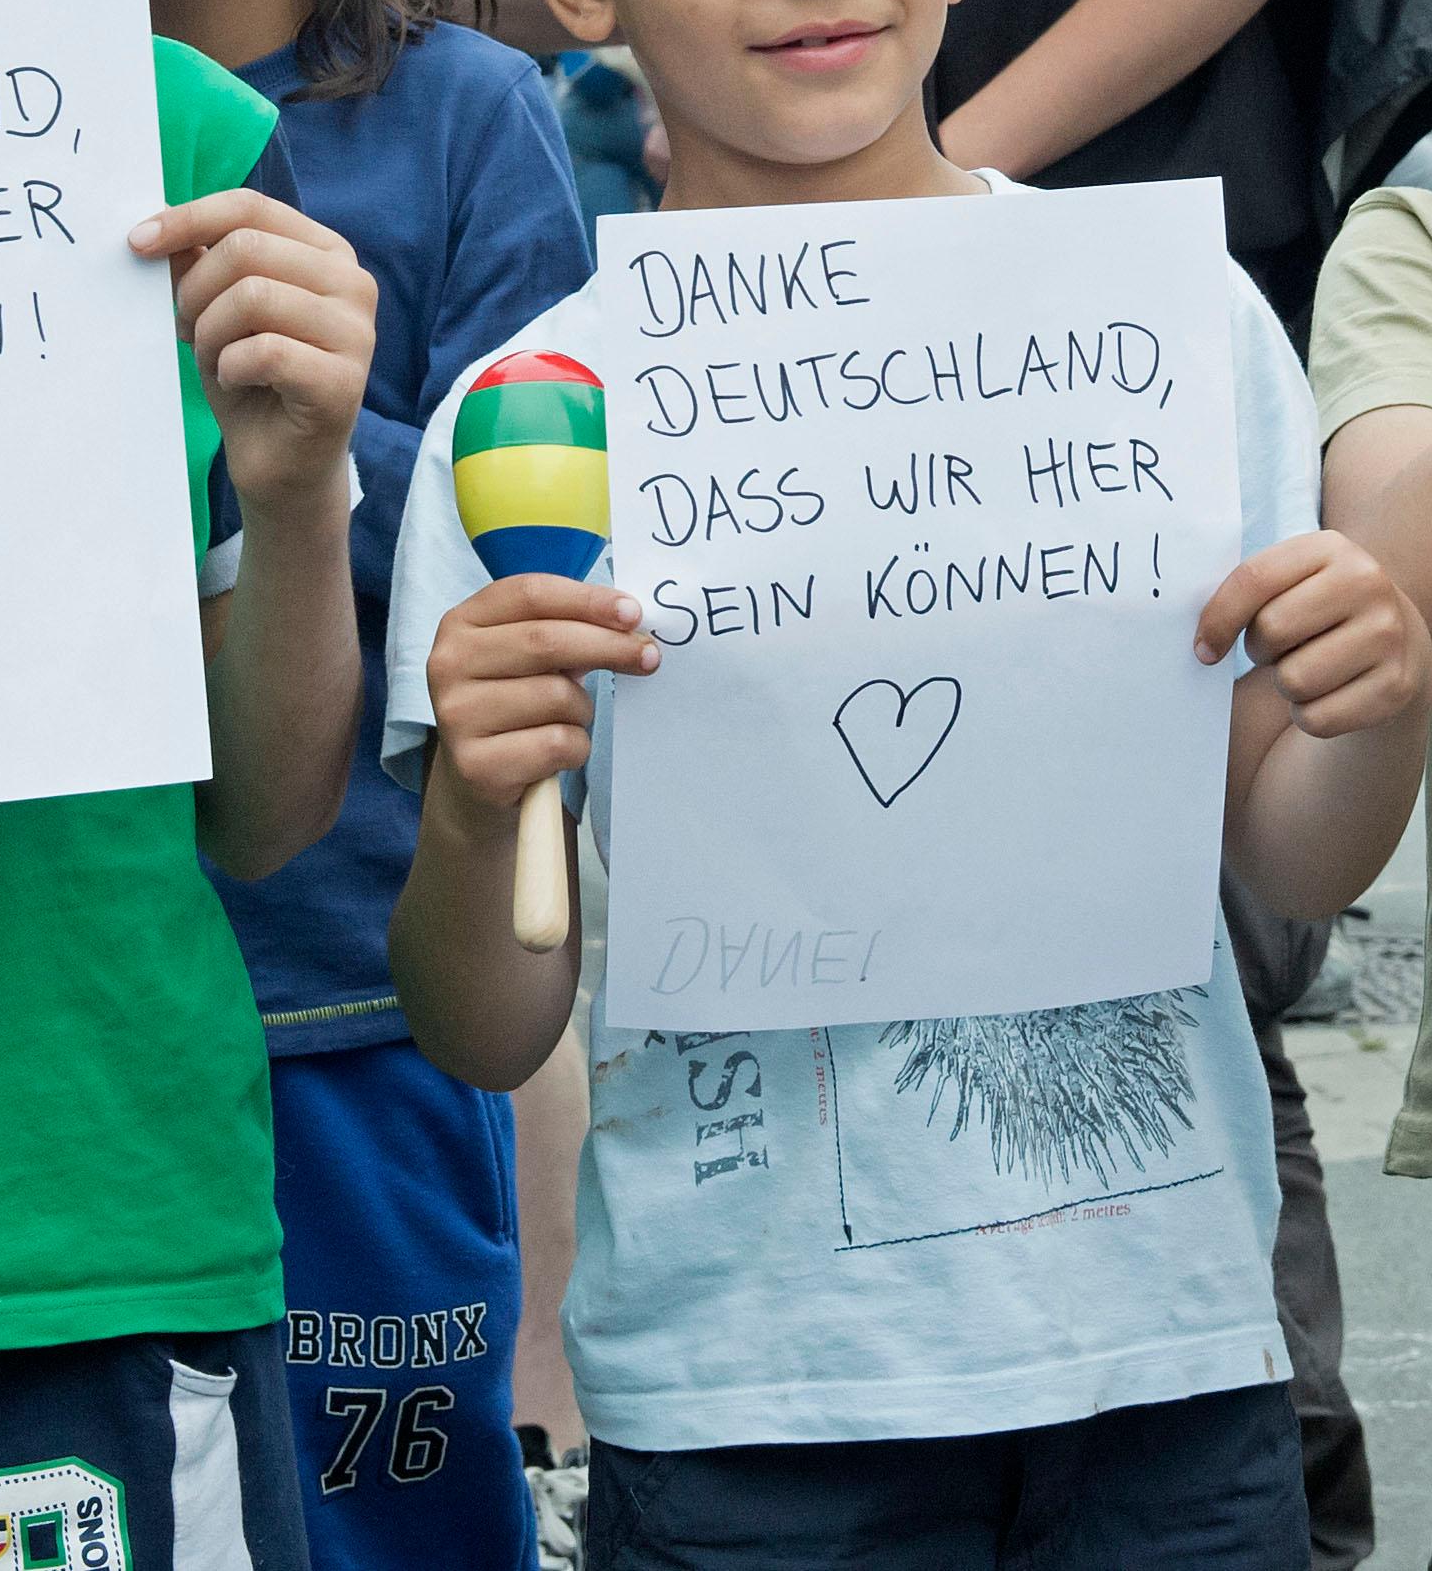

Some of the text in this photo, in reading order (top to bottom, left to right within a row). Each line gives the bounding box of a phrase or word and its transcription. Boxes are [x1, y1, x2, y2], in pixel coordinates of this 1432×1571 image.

[629, 240, 870, 338] DANKE
[635, 322, 1174, 438] DEUTSCHLAND,
[639, 437, 1174, 547] DASS WIR HIER
[650, 574, 814, 647] SEIN
[286, 1301, 487, 1369] BRONX
[321, 1384, 456, 1496] 76
